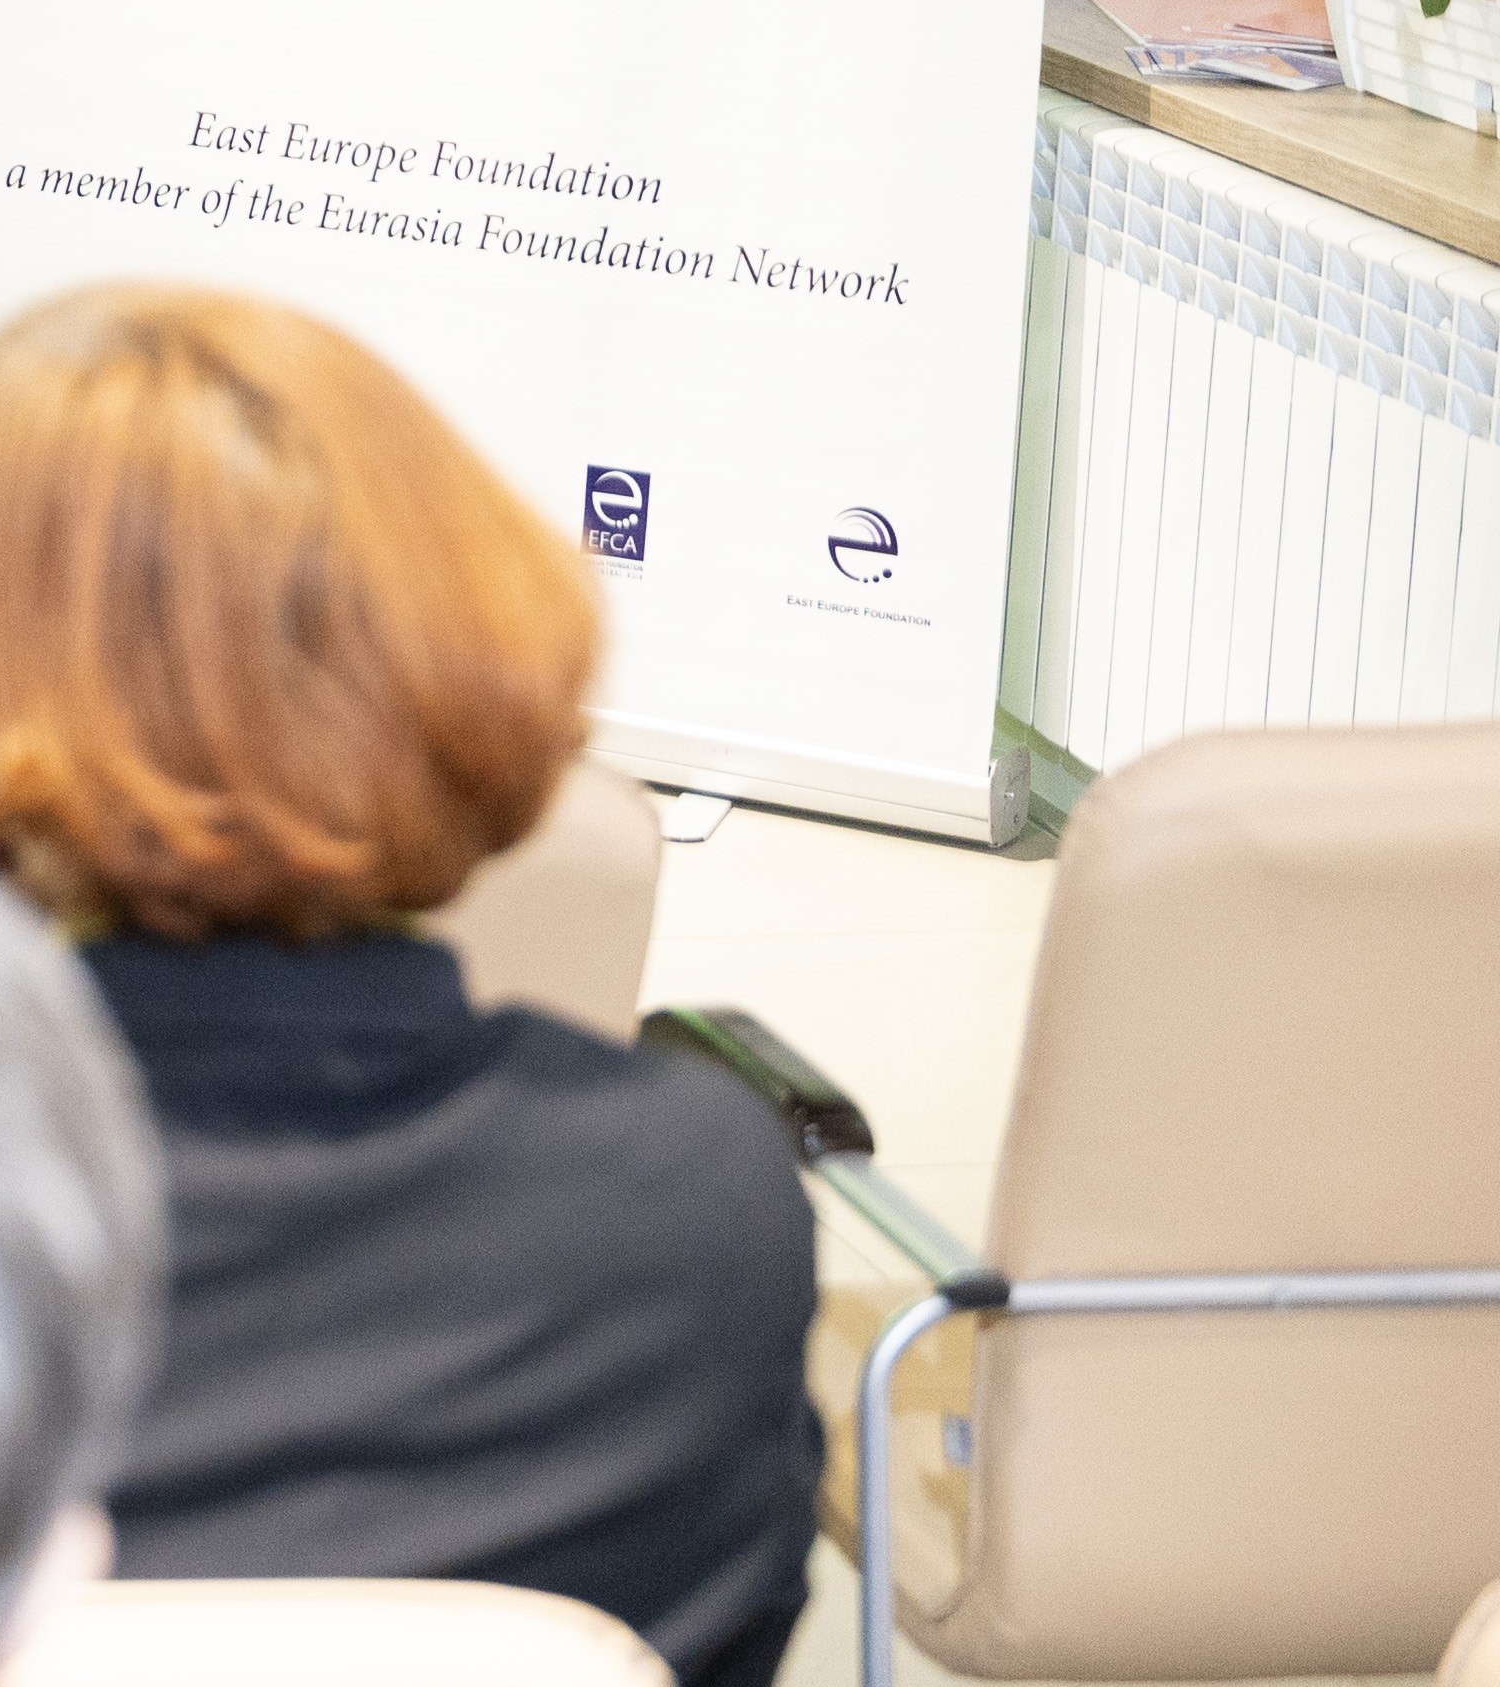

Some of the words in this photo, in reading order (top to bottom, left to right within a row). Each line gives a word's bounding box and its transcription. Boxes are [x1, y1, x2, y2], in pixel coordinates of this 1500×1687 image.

[188, 110, 269, 155] East
[280, 122, 417, 182] Europe
[430, 139, 662, 204] Foundation
[6, 163, 26, 189] a
[40, 166, 190, 212] member
[200, 178, 244, 229] of
[247, 183, 305, 226] the
[316, 192, 462, 247] Eurasia
[476, 213, 714, 280] Foundation
[728, 244, 909, 306] Network
[588, 529, 637, 554] EFCA
